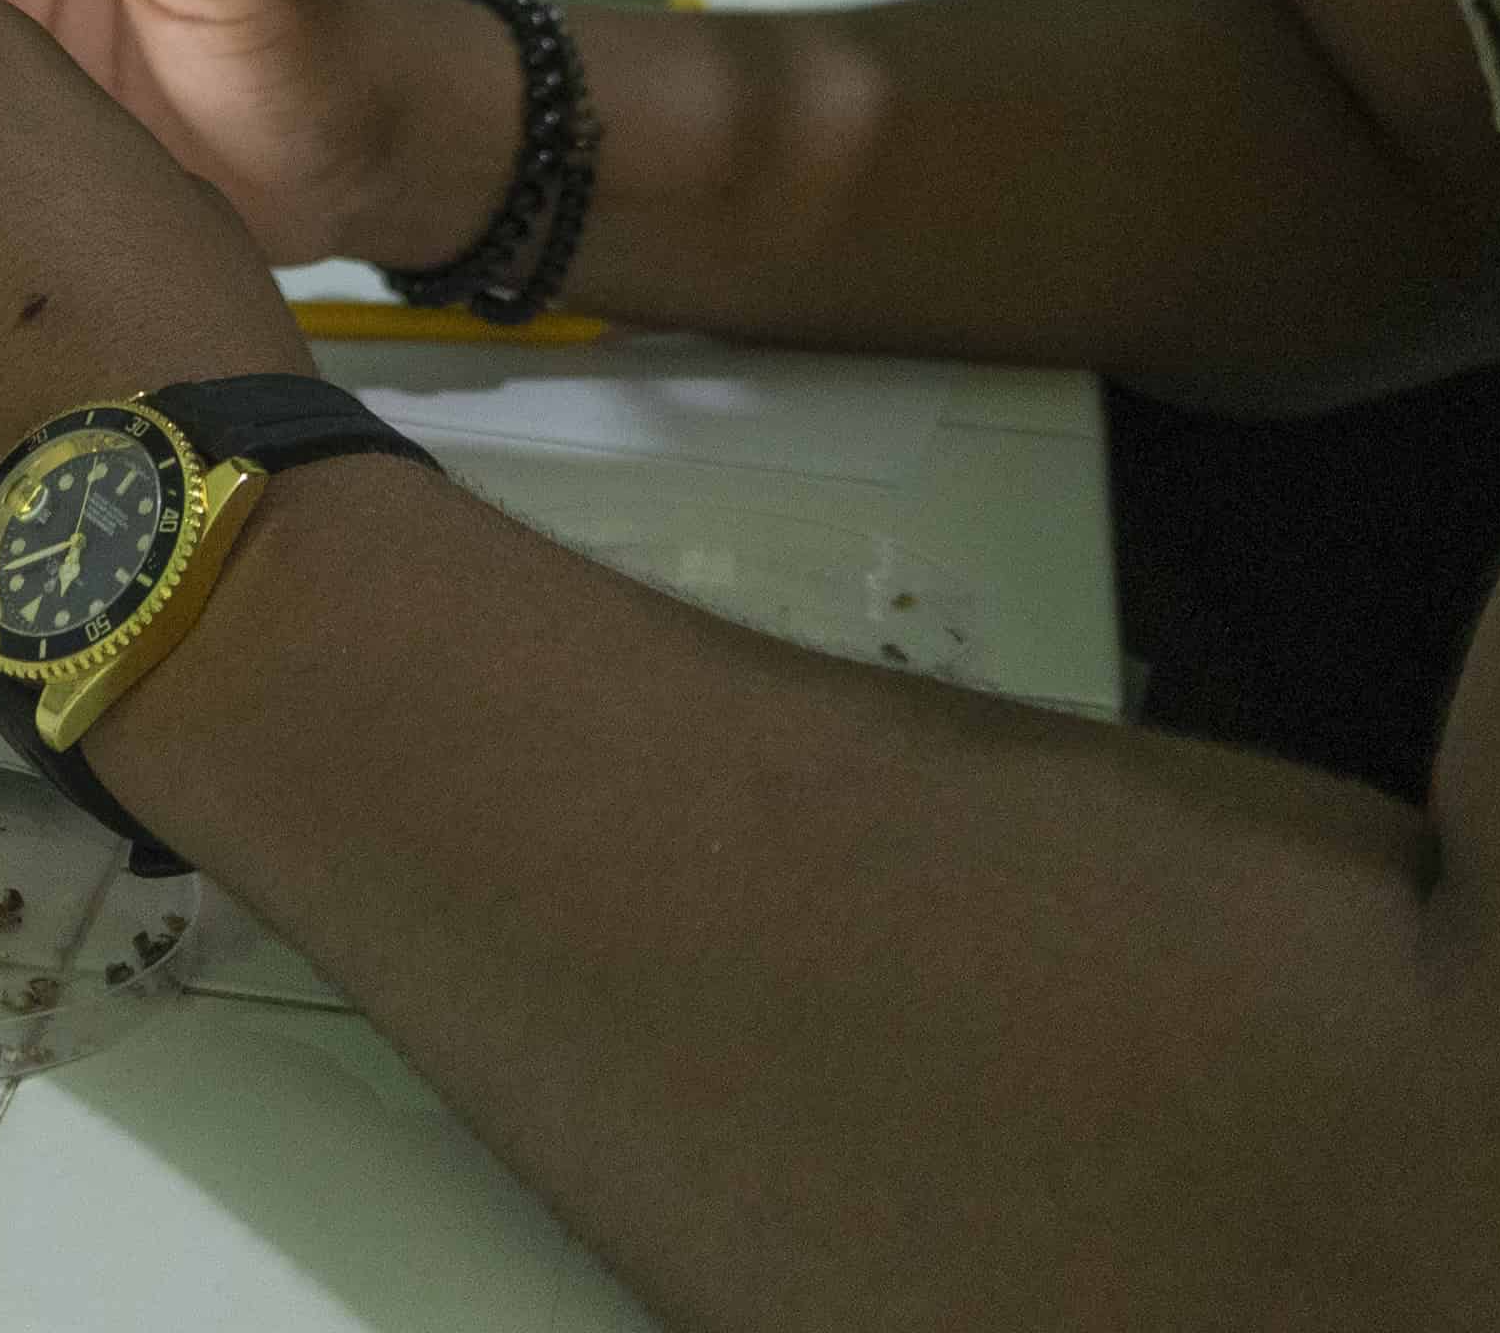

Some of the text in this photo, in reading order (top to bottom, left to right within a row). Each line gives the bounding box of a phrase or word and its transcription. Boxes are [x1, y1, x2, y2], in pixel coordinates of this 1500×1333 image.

[126, 414, 150, 438] 30
[158, 508, 179, 534] 40
[84, 616, 113, 642] 50
